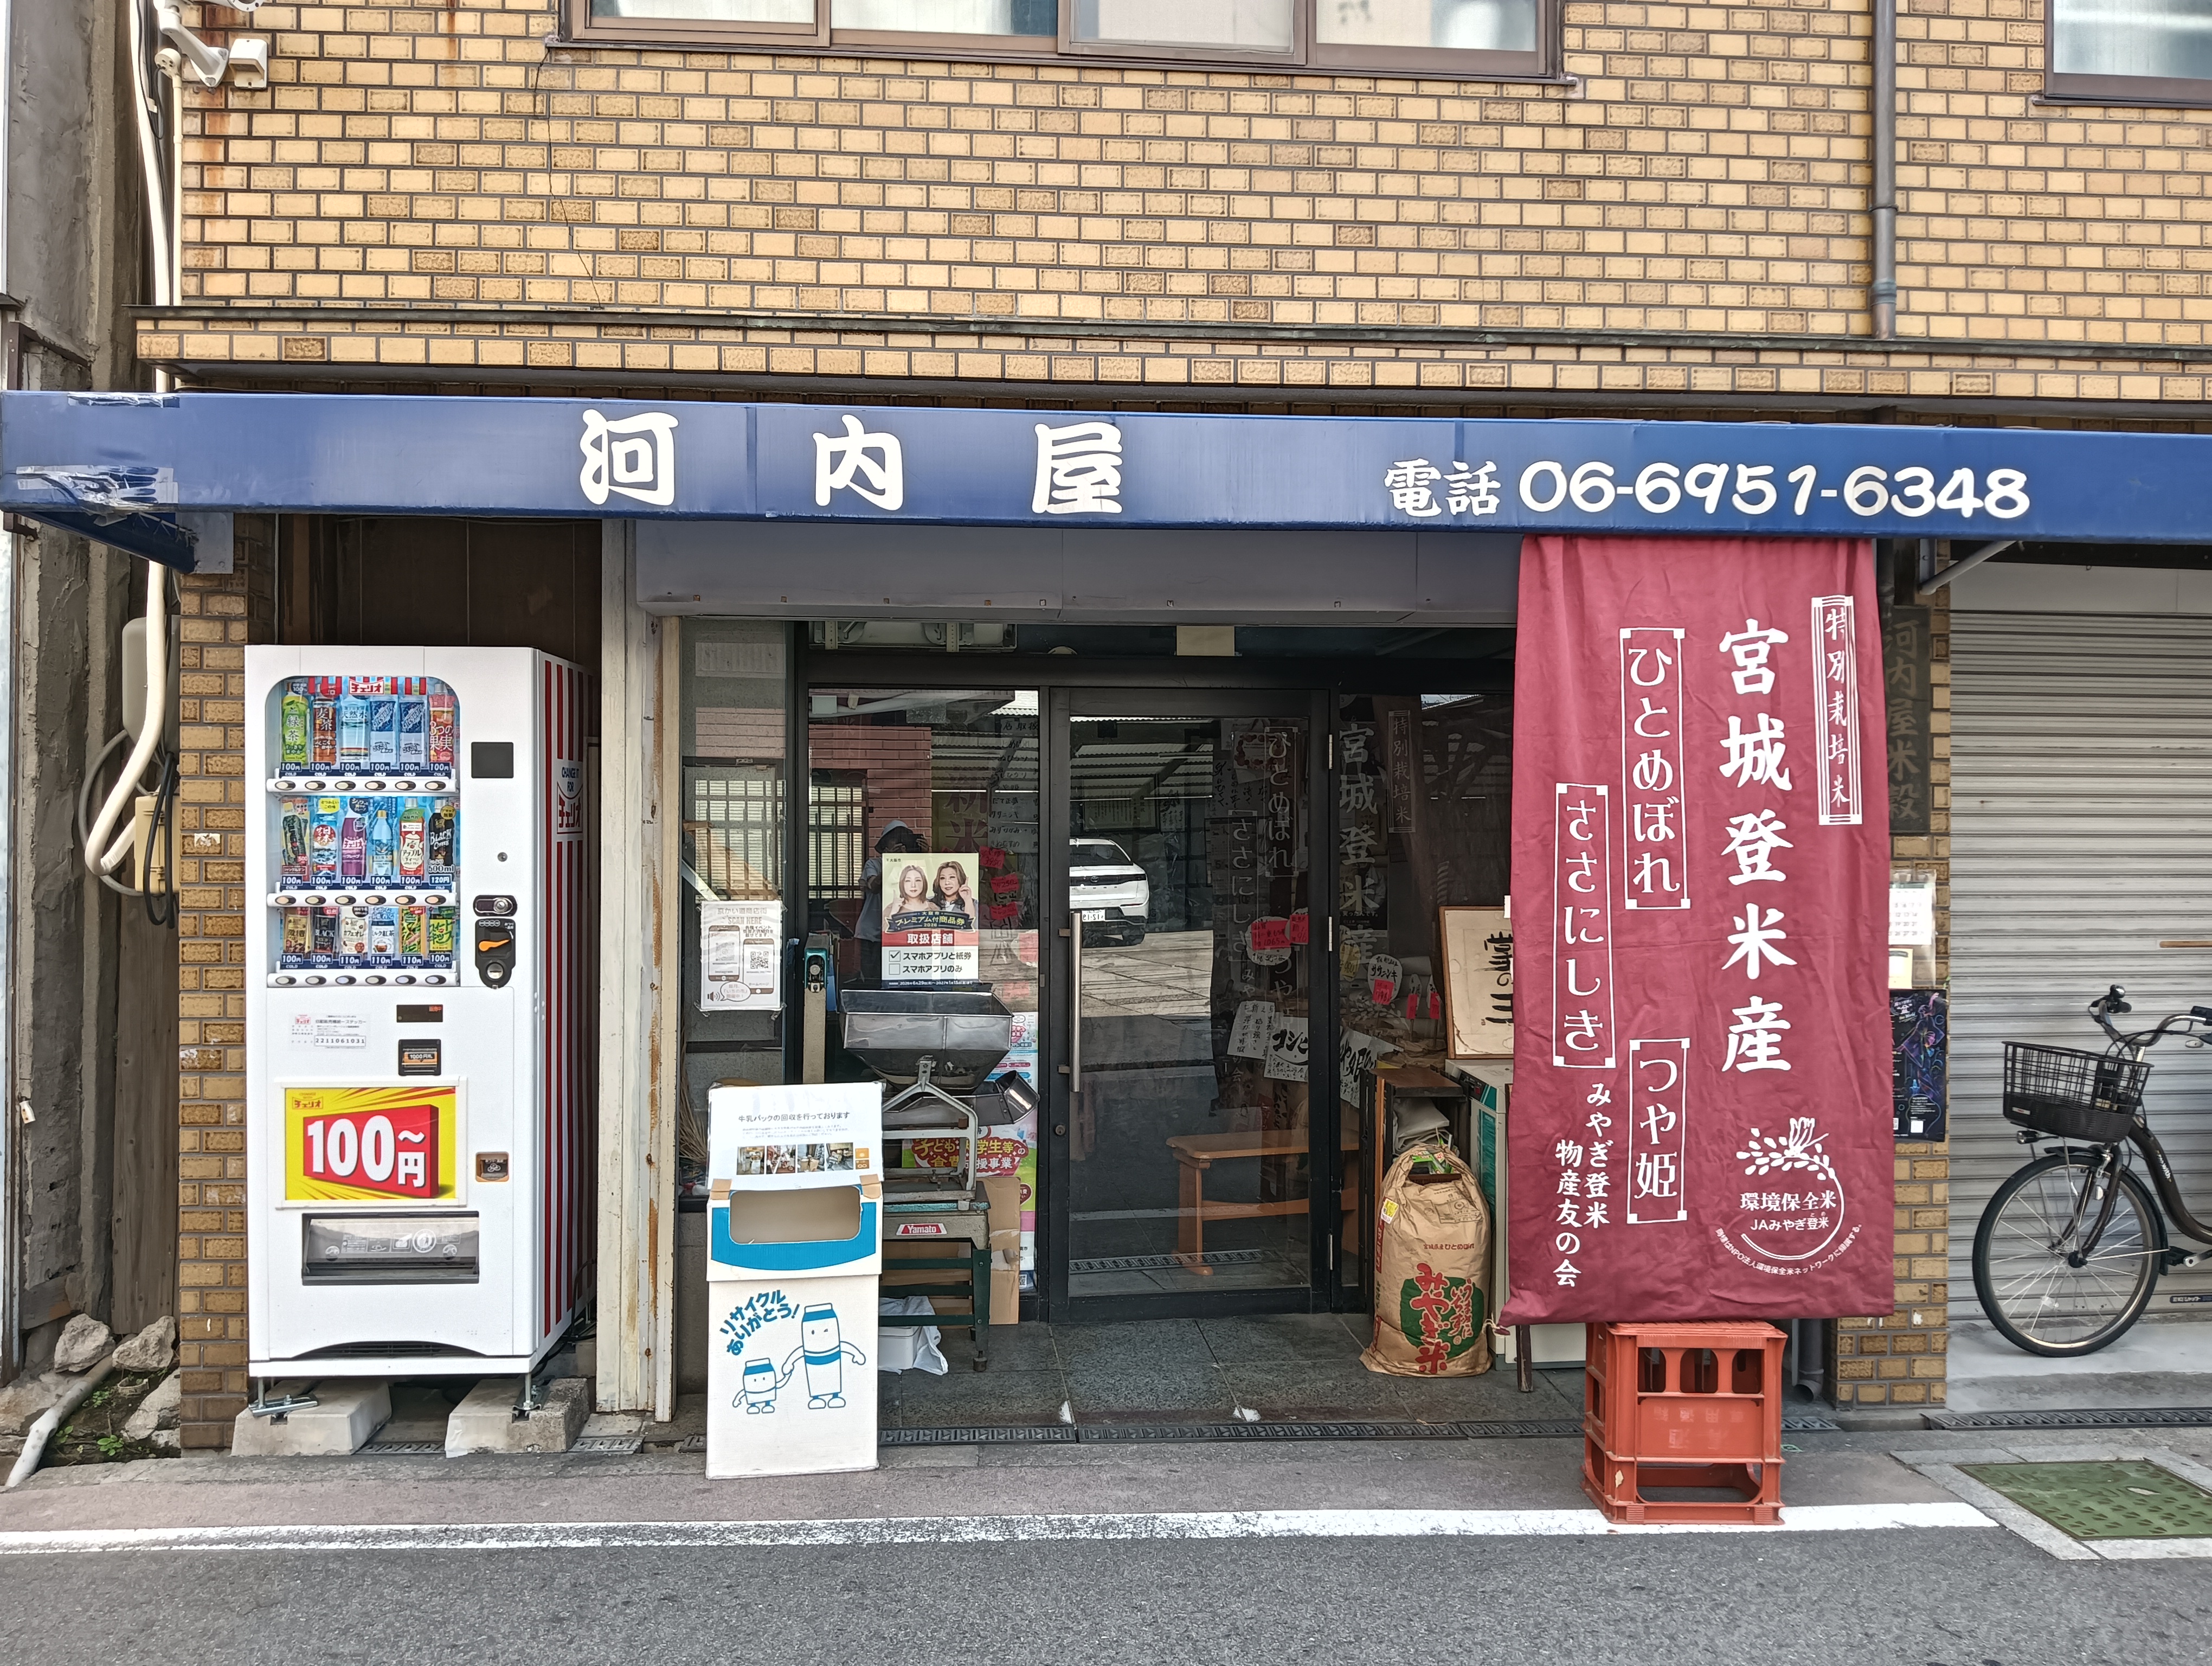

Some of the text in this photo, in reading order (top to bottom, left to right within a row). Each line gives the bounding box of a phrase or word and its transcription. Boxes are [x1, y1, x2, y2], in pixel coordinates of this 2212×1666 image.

[580, 409, 1123, 514] 河内屋
[1384, 459, 2030, 518] 電話 06-6951-6348
[351, 683, 382, 693] チェリオ
[317, 708, 332, 731] 麦茶
[342, 710, 368, 719] 天然水
[287, 715, 300, 742] 緑茶
[429, 735, 453, 751] 果実
[1628, 648, 1680, 894] ひとめぼれ
[559, 794, 581, 828] チェリオ
[430, 828, 452, 845] BLACK
[1719, 618, 1798, 1073] 宮城登米産
[428, 864, 455, 873] 500ml
[282, 876, 301, 885] 100円
[312, 876, 331, 885] 100円
[342, 876, 361, 885] 100円
[371, 876, 390, 885] 100円
[401, 876, 420, 885] 100円
[431, 876, 449, 885] 120円
[728, 917, 745, 925] SCAN
[895, 916, 965, 926] プレミアム付商品券
[1564, 799, 1604, 1050] ささにしき
[907, 933, 953, 944] 取扱店舗
[903, 952, 972, 960] スマホアプリと紙券
[902, 965, 963, 973] スマホアプリのみ
[294, 1099, 321, 1108] チェリオ
[738, 1111, 850, 1123] 牛乳パックの回収を行っております
[1635, 1058, 1678, 1199] つや姫
[1584, 1083, 1613, 1228] みやぎ登米
[1739, 1190, 1837, 1212] 環境保全米
[1553, 1140, 1583, 1287] 物産友の会
[907, 1225, 937, 1234] Yamato
[1751, 1217, 1830, 1231] JAみやぎ登米
[719, 1290, 786, 1335] リサイクル
[1411, 1263, 1451, 1375] みやぎ米
